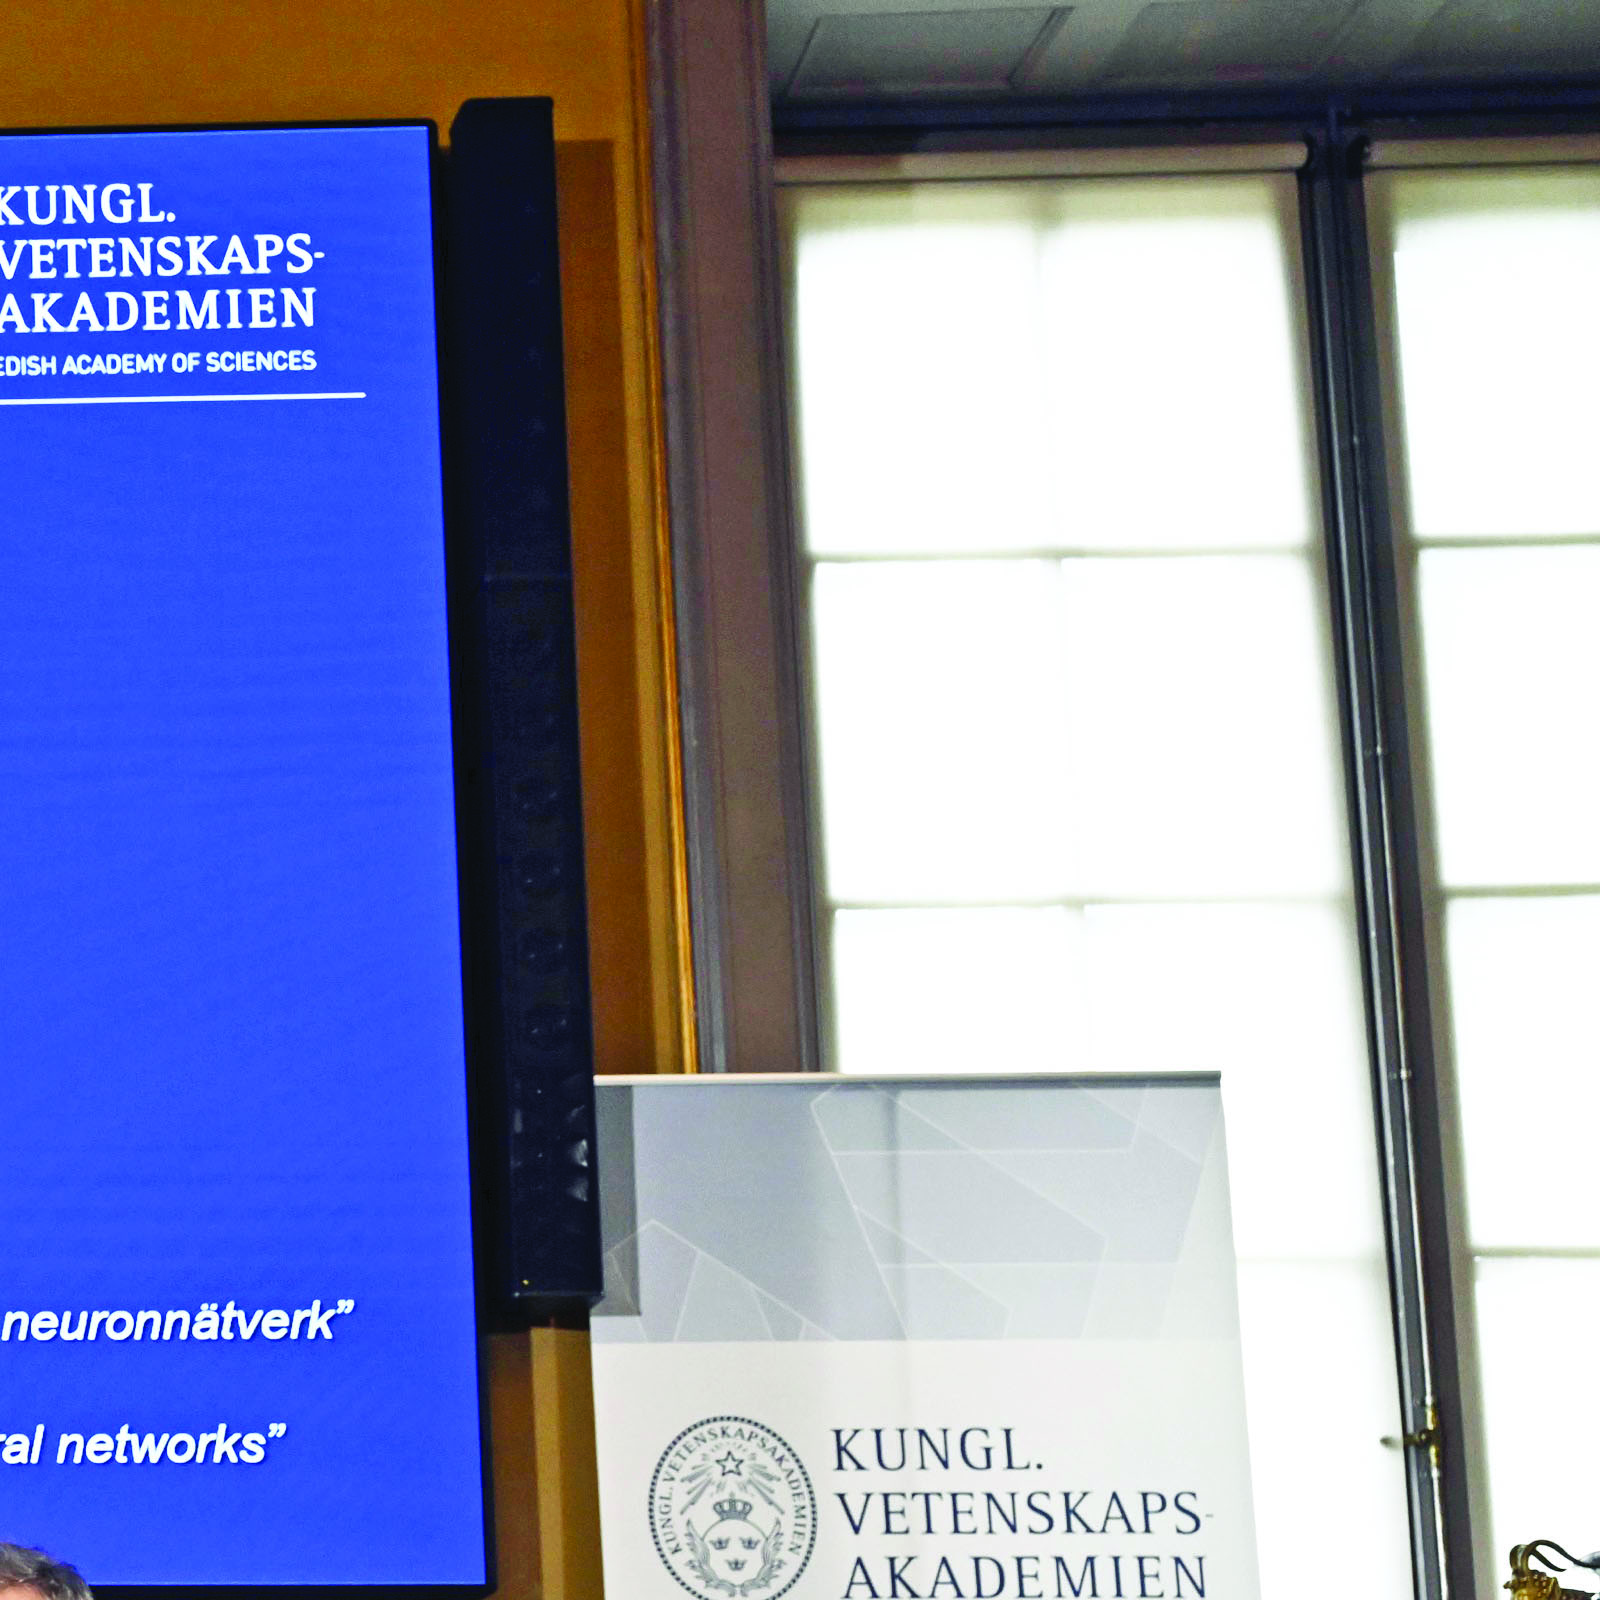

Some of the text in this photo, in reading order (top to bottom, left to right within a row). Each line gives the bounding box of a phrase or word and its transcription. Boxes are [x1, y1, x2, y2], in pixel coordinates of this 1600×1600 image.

[62, 354, 167, 374] ACADEMY
[172, 353, 200, 372] OF
[206, 350, 317, 372] SCIENCES
[832, 1428, 1042, 1471] KUNGL.
[662, 1426, 806, 1556] VETENSKAPSAKADEMIEN
[843, 1556, 1205, 1599] AKADEMIEN
